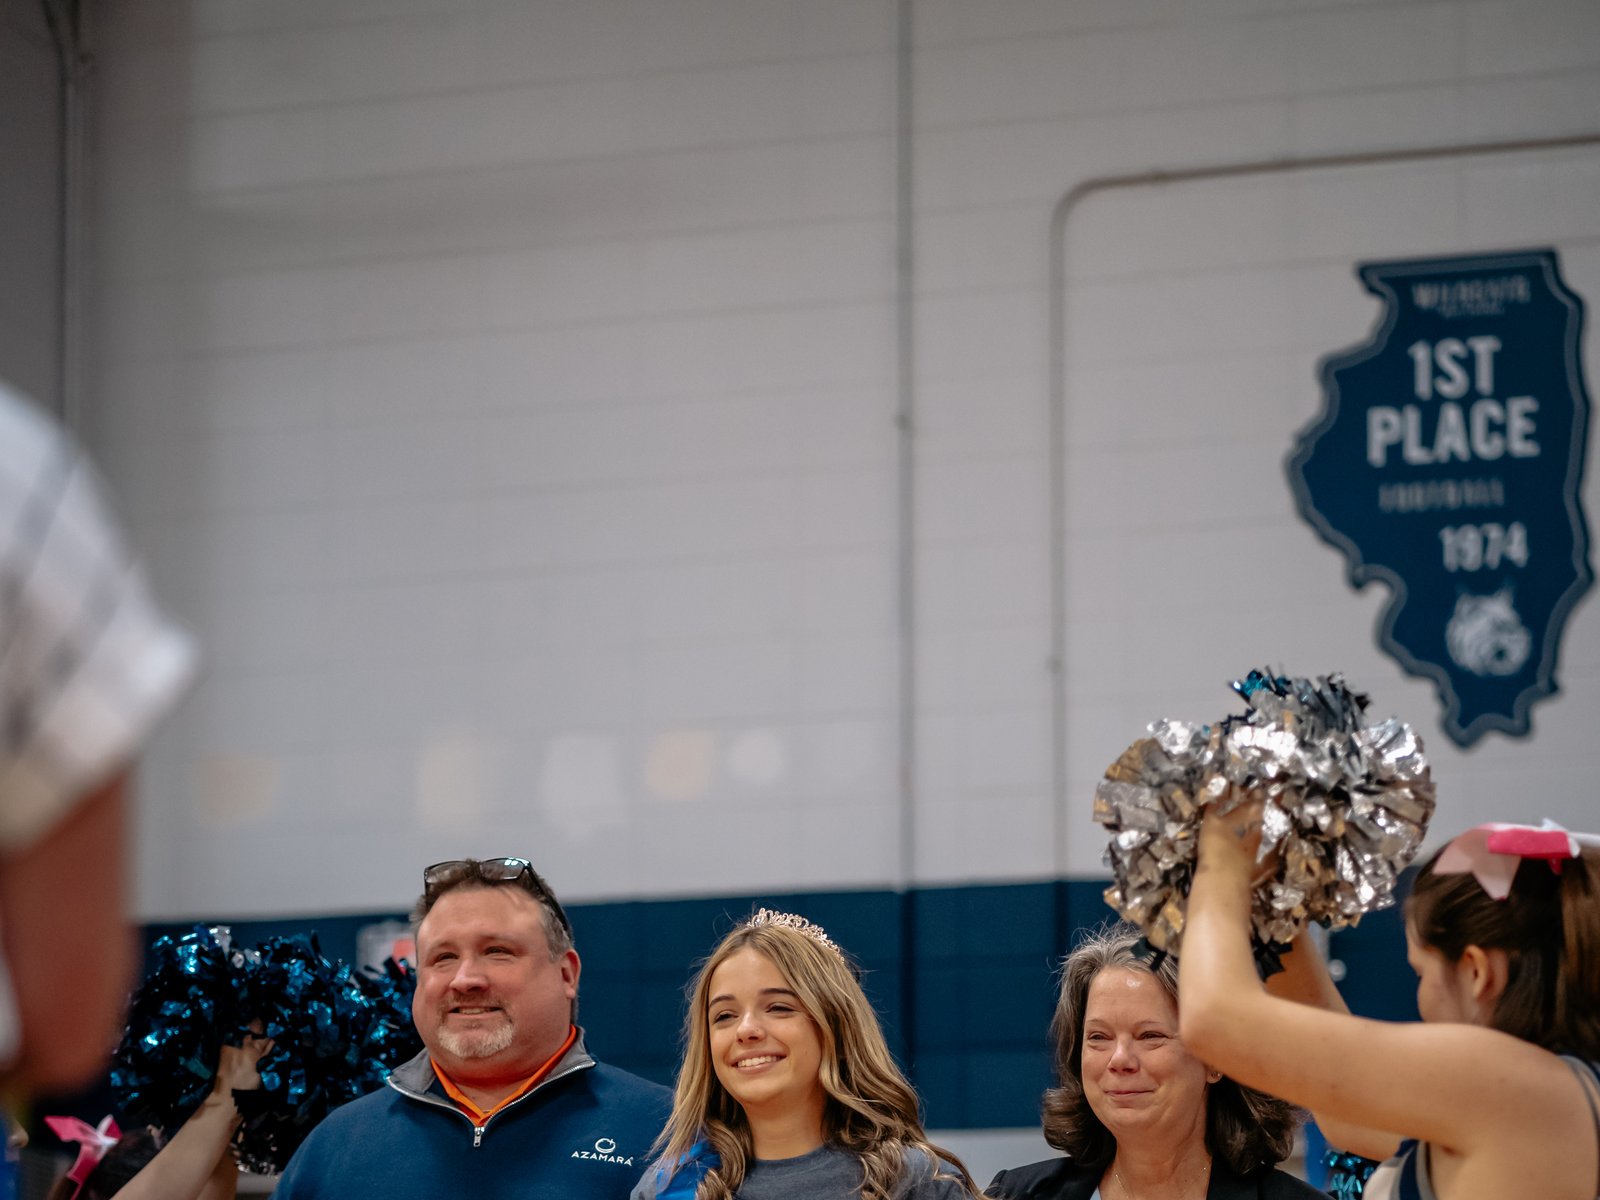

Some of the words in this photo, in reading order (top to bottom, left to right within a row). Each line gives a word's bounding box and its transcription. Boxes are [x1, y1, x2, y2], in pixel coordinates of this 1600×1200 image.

[1407, 335, 1502, 400] 1ST
[1366, 396, 1541, 468] PLACE
[1439, 521, 1529, 573] 1974
[571, 1151, 632, 1167] AZAMARA
